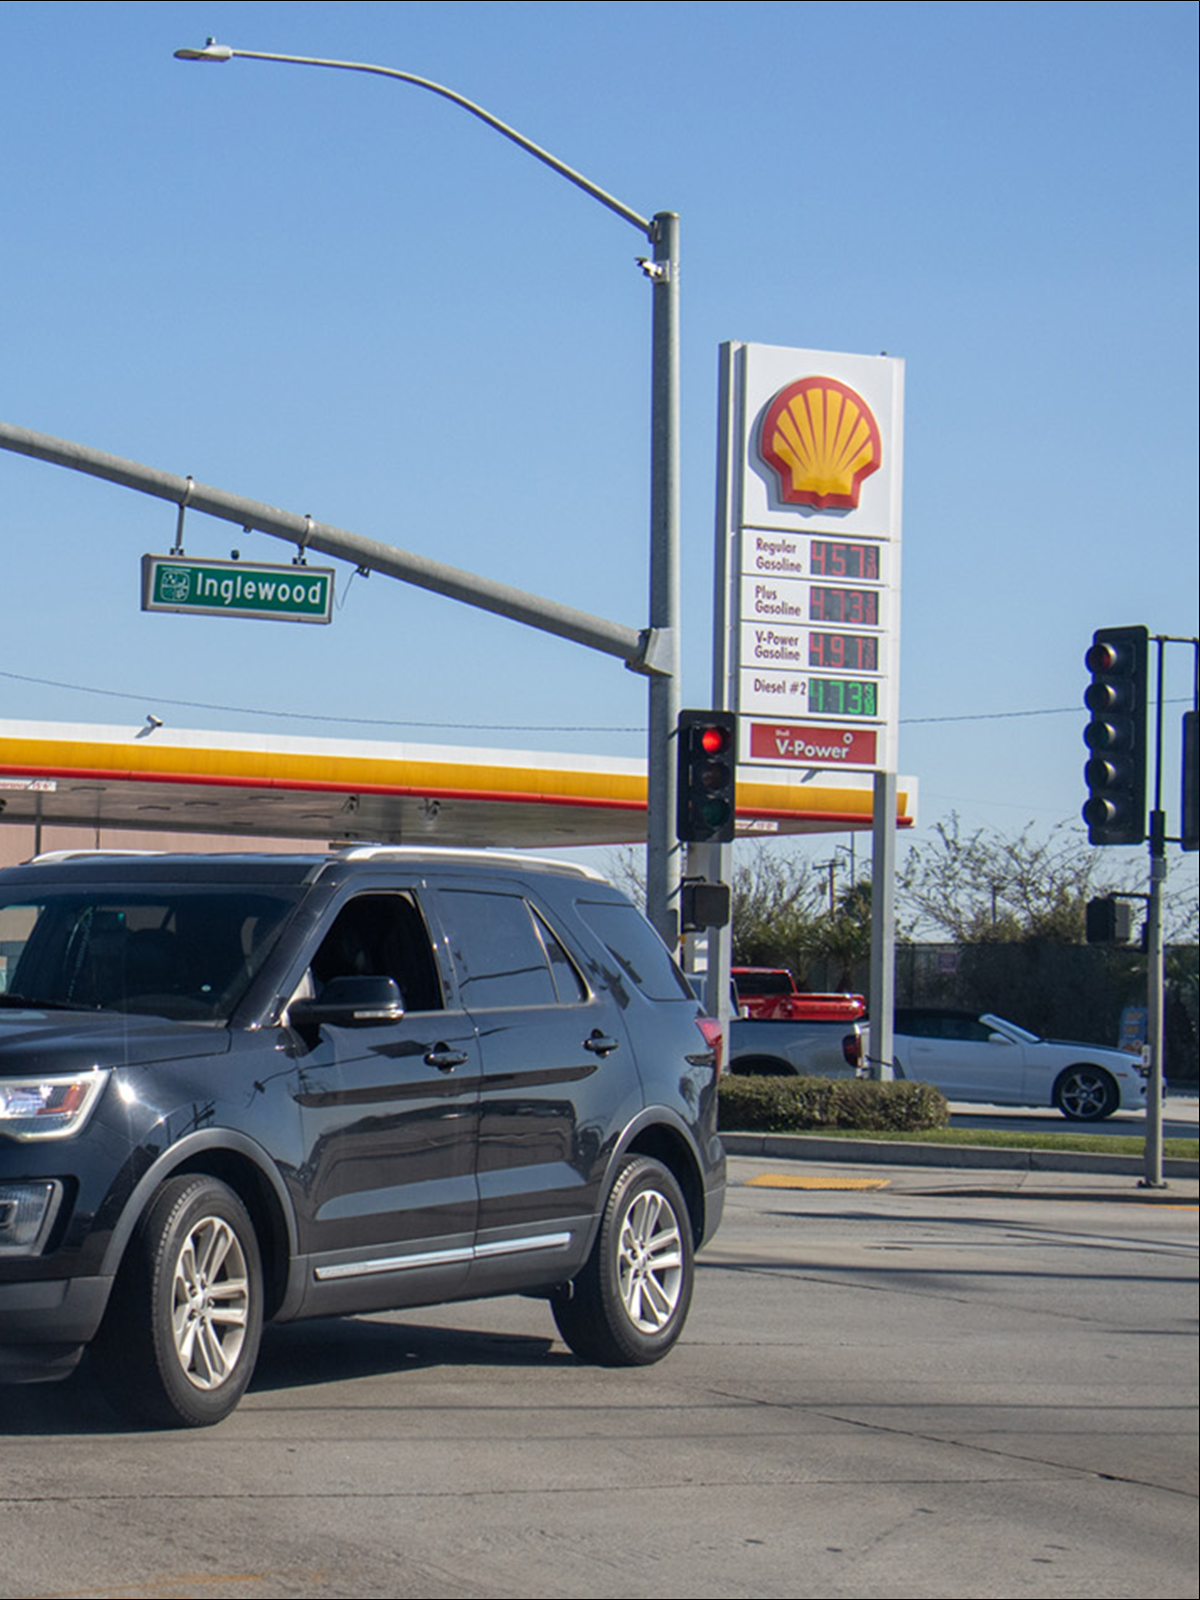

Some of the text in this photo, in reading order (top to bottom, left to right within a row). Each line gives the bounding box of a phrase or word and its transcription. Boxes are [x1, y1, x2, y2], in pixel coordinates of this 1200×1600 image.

[756, 537, 797, 555] Regular
[756, 556, 802, 573] Gasoline
[196, 572, 321, 605] Inglewood
[755, 585, 777, 600] Plus
[755, 599, 802, 616] Gasoline
[755, 630, 799, 647] V-Power
[754, 645, 801, 661] Gasoline
[754, 678, 807, 696] Diesel #2
[775, 738, 850, 759] V-Power
